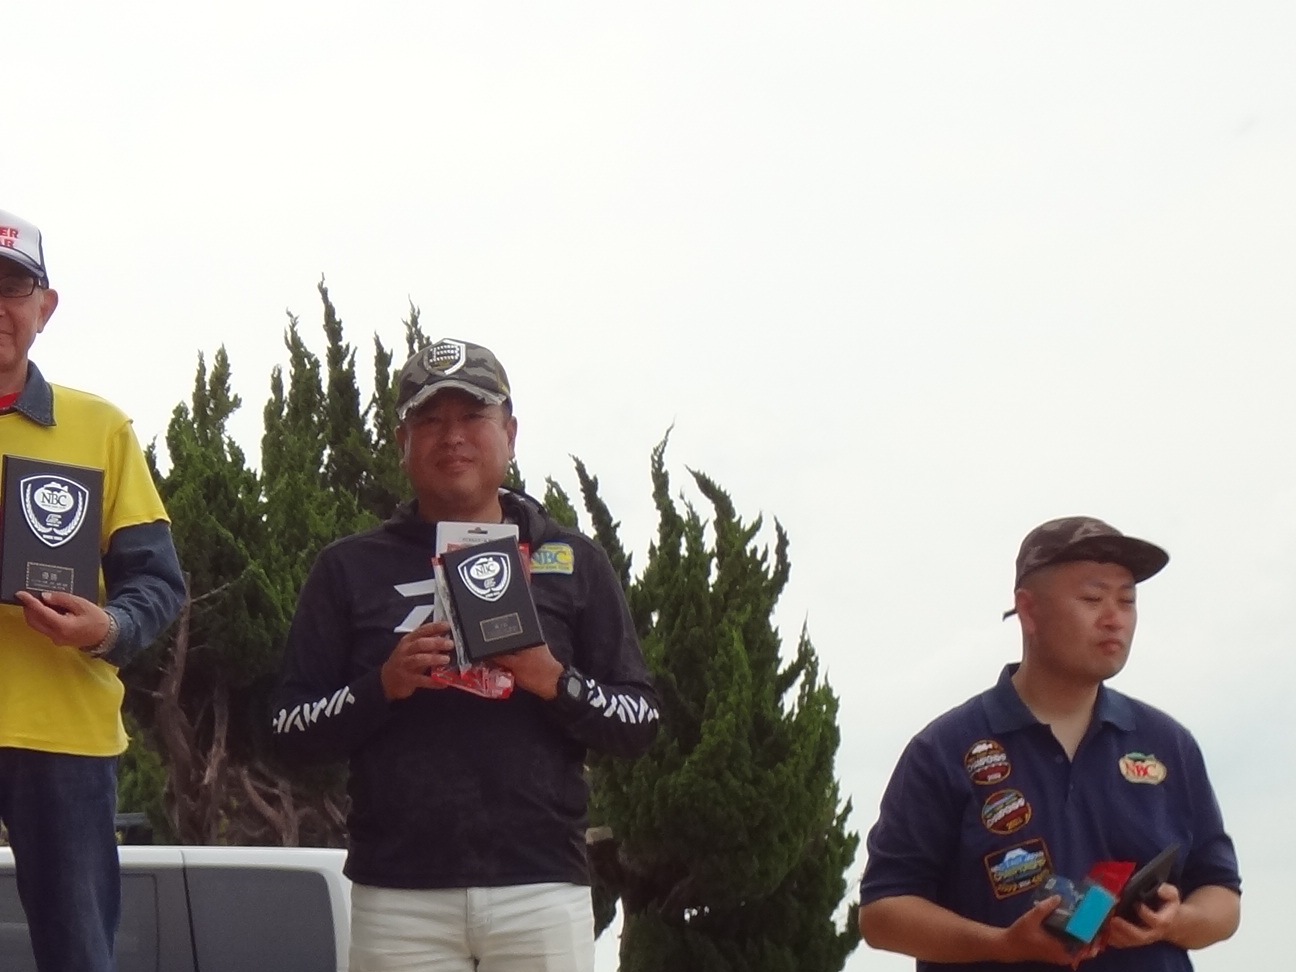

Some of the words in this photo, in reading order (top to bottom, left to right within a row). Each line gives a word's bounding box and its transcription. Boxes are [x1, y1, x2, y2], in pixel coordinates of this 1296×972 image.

[41, 491, 67, 506] NBC
[475, 563, 496, 575] NBC
[1123, 761, 1159, 779] NBC
